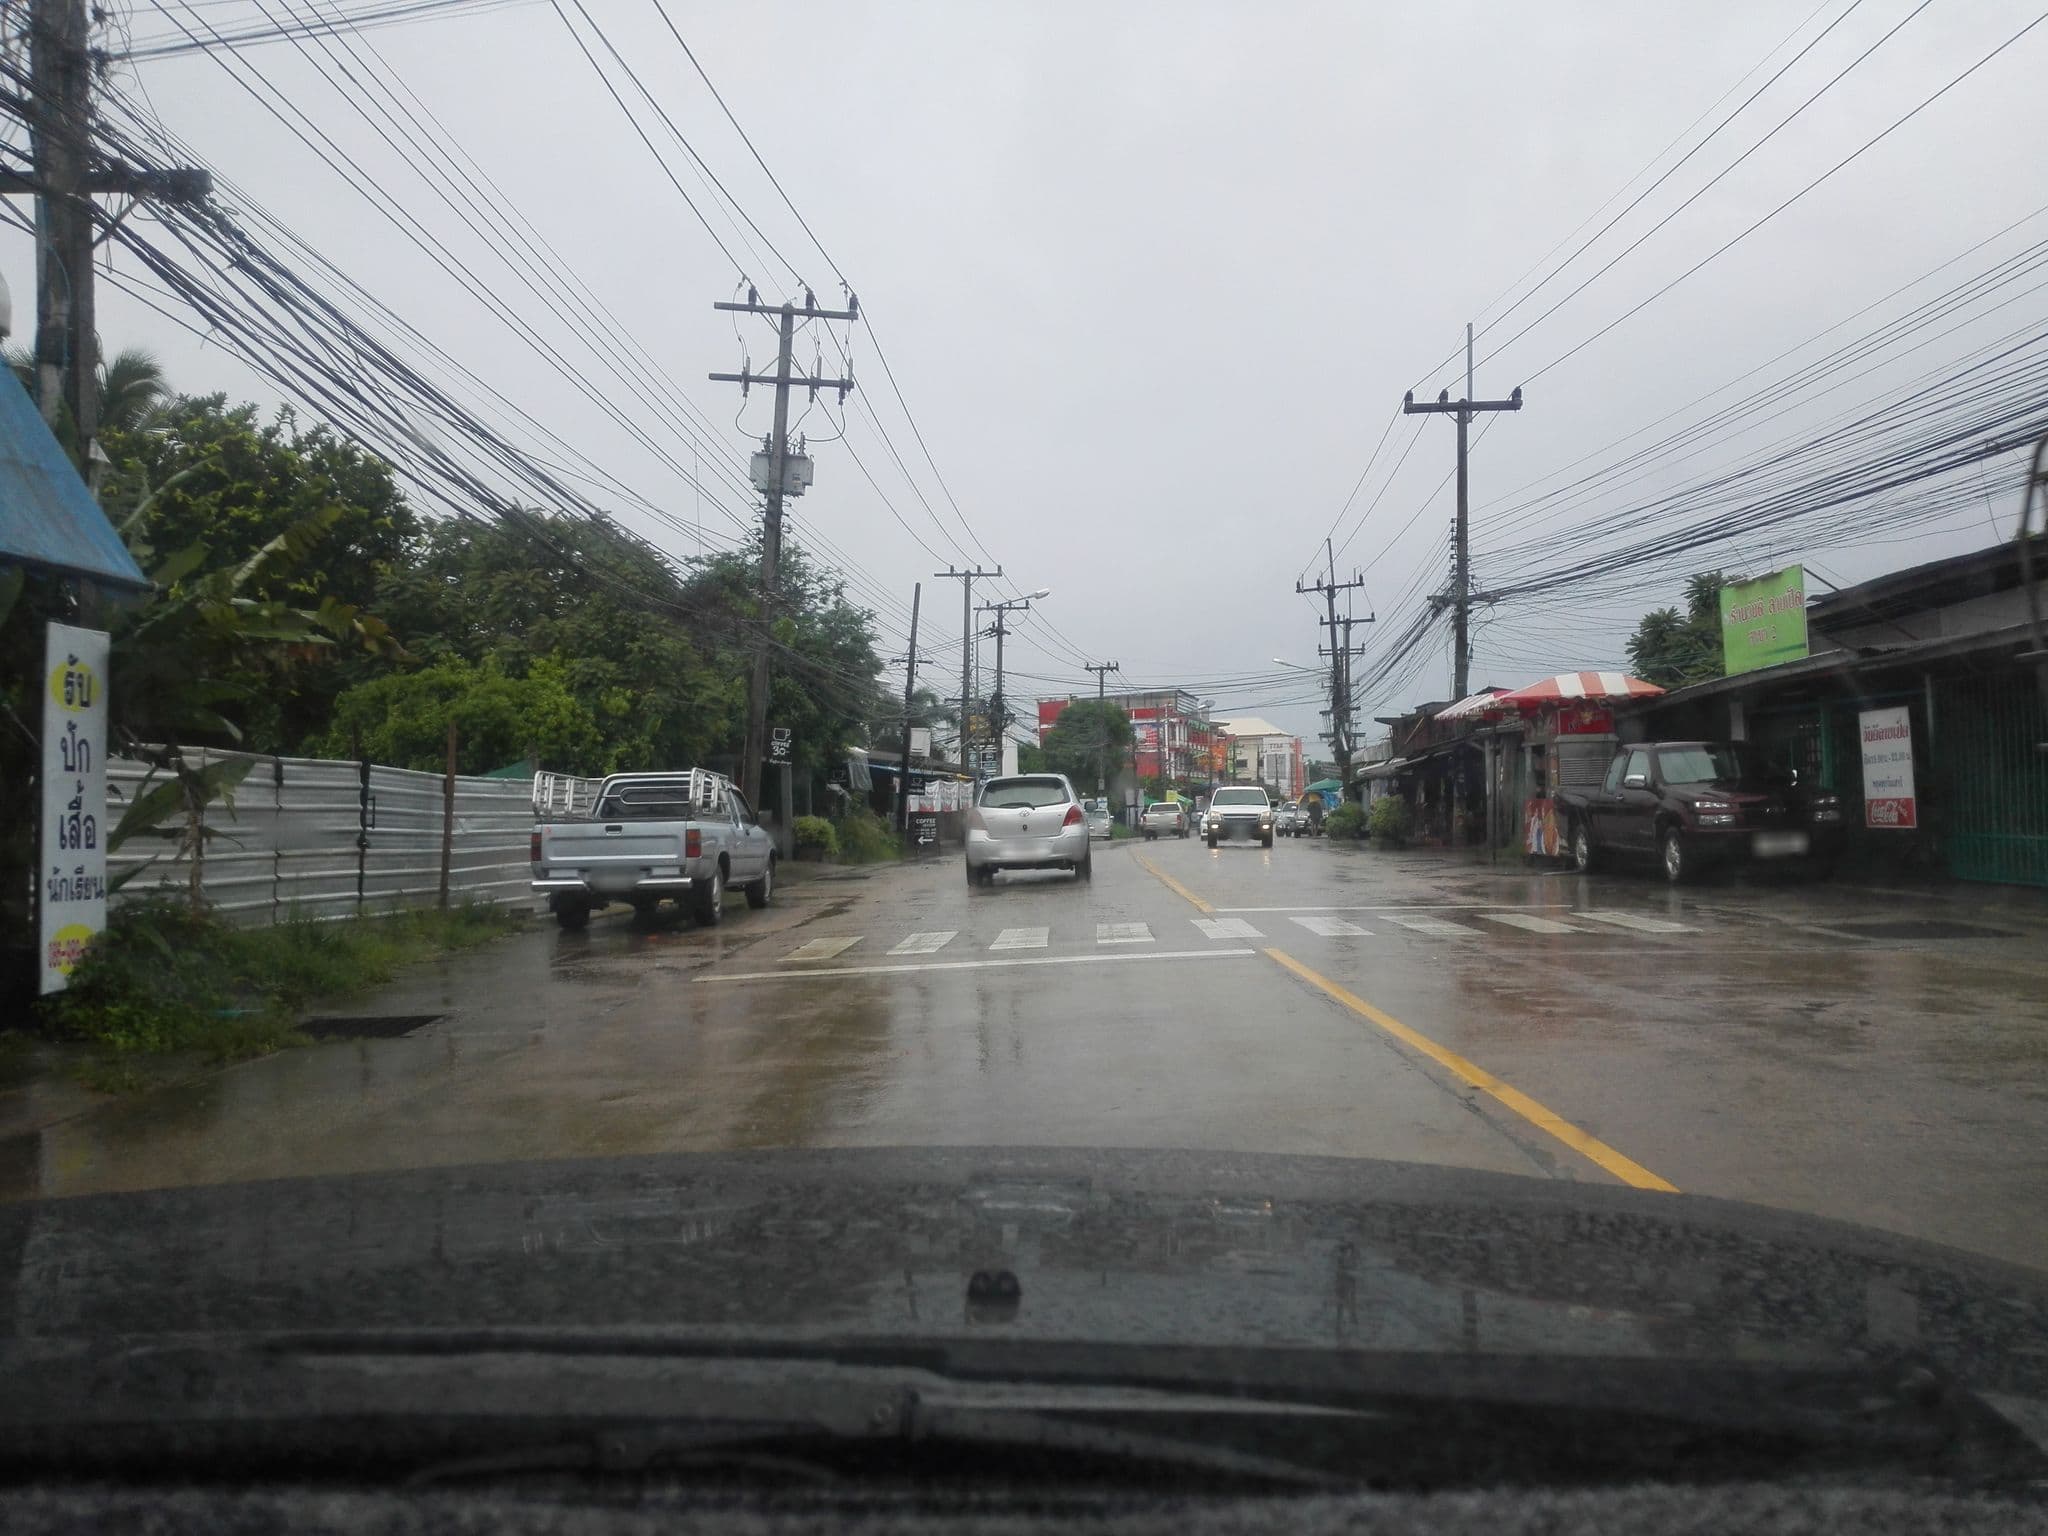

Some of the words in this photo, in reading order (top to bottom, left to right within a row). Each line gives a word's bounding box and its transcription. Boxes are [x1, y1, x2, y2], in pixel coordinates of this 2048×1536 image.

[63, 653, 92, 708] รับ
[60, 720, 91, 773] ปัก
[59, 780, 96, 850] เสื้อ
[47, 865, 104, 903] นักเรียน
